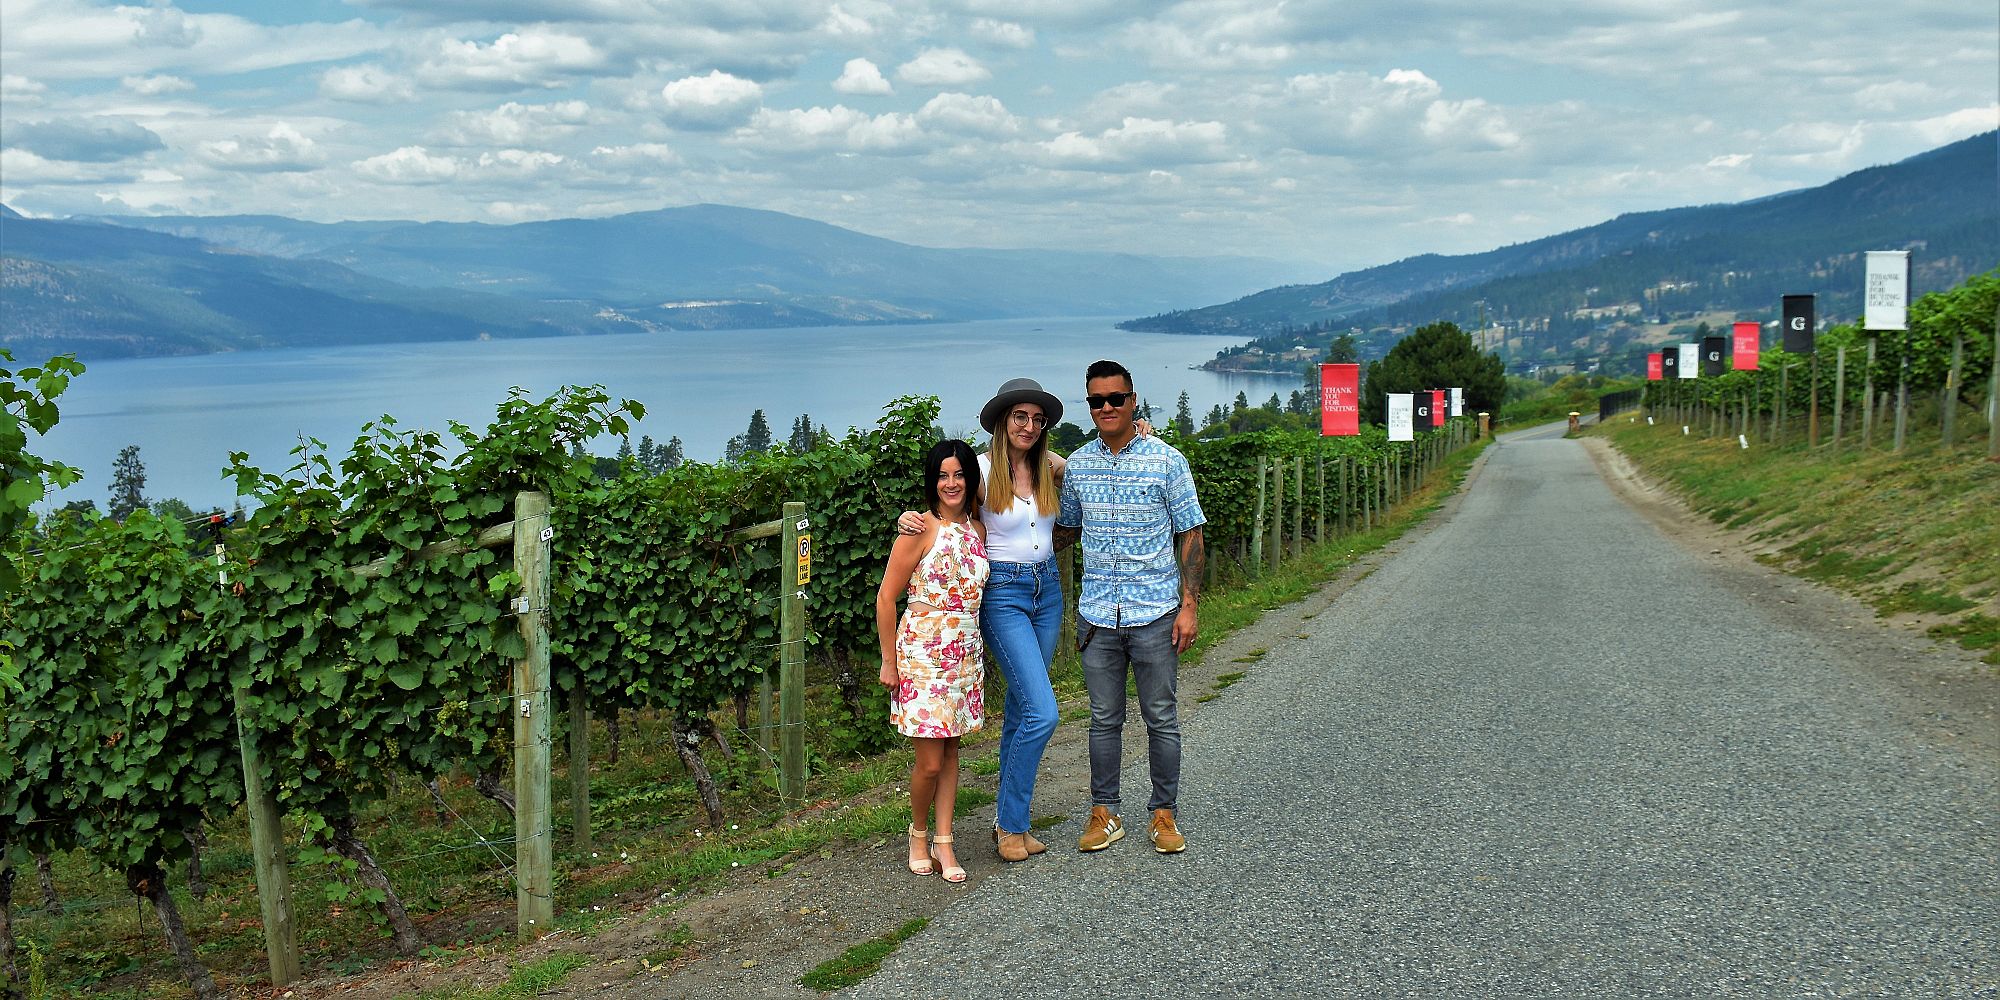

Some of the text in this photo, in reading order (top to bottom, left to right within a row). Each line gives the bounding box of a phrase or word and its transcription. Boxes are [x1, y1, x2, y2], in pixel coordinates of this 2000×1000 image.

[1790, 316, 1806, 331] G
[1708, 351, 1720, 362] G
[1418, 406, 1428, 416] G
[800, 564, 808, 573] FIRE
